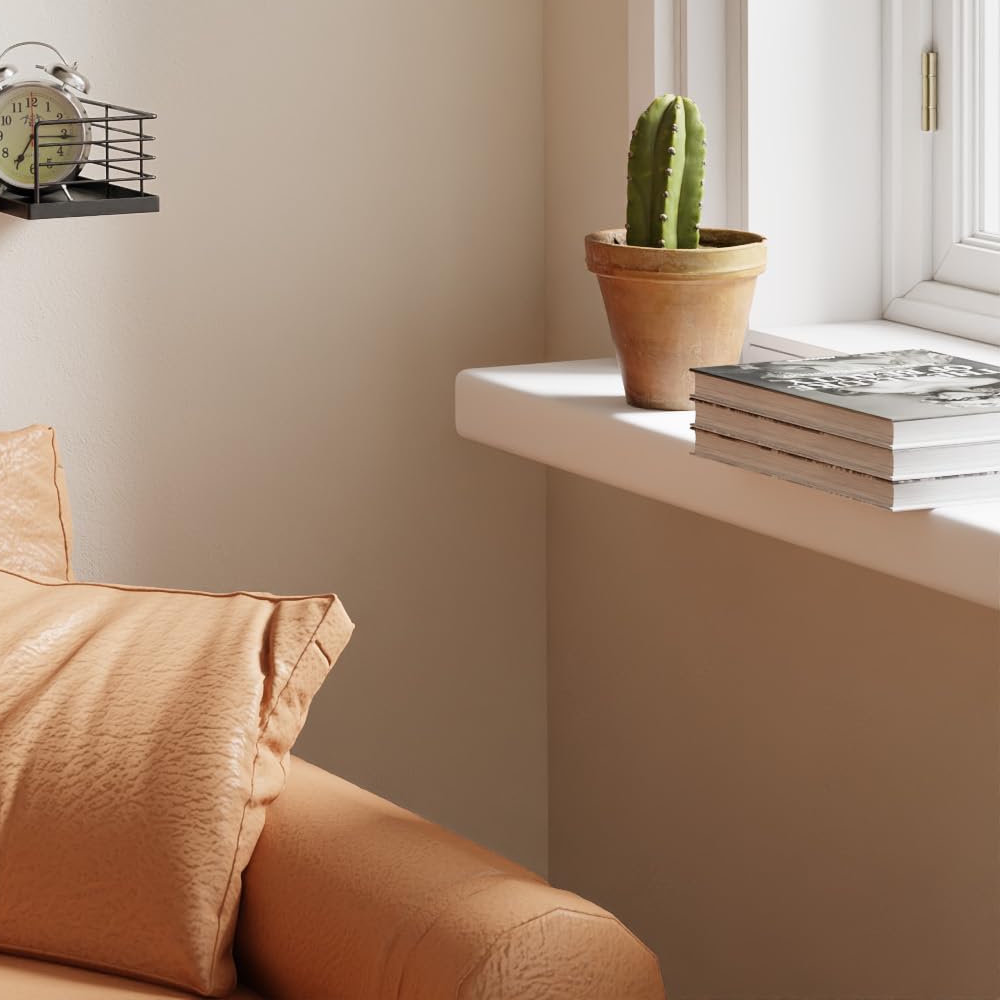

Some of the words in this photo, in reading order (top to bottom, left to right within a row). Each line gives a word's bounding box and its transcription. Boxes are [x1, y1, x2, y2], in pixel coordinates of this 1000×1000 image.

[12, 102, 22, 113] 11
[26, 97, 38, 108] 12
[46, 102, 51, 112] 1
[1, 115, 12, 126] 10
[60, 128, 68, 139] 3
[2, 147, 9, 158] 8
[56, 146, 64, 156] 4
